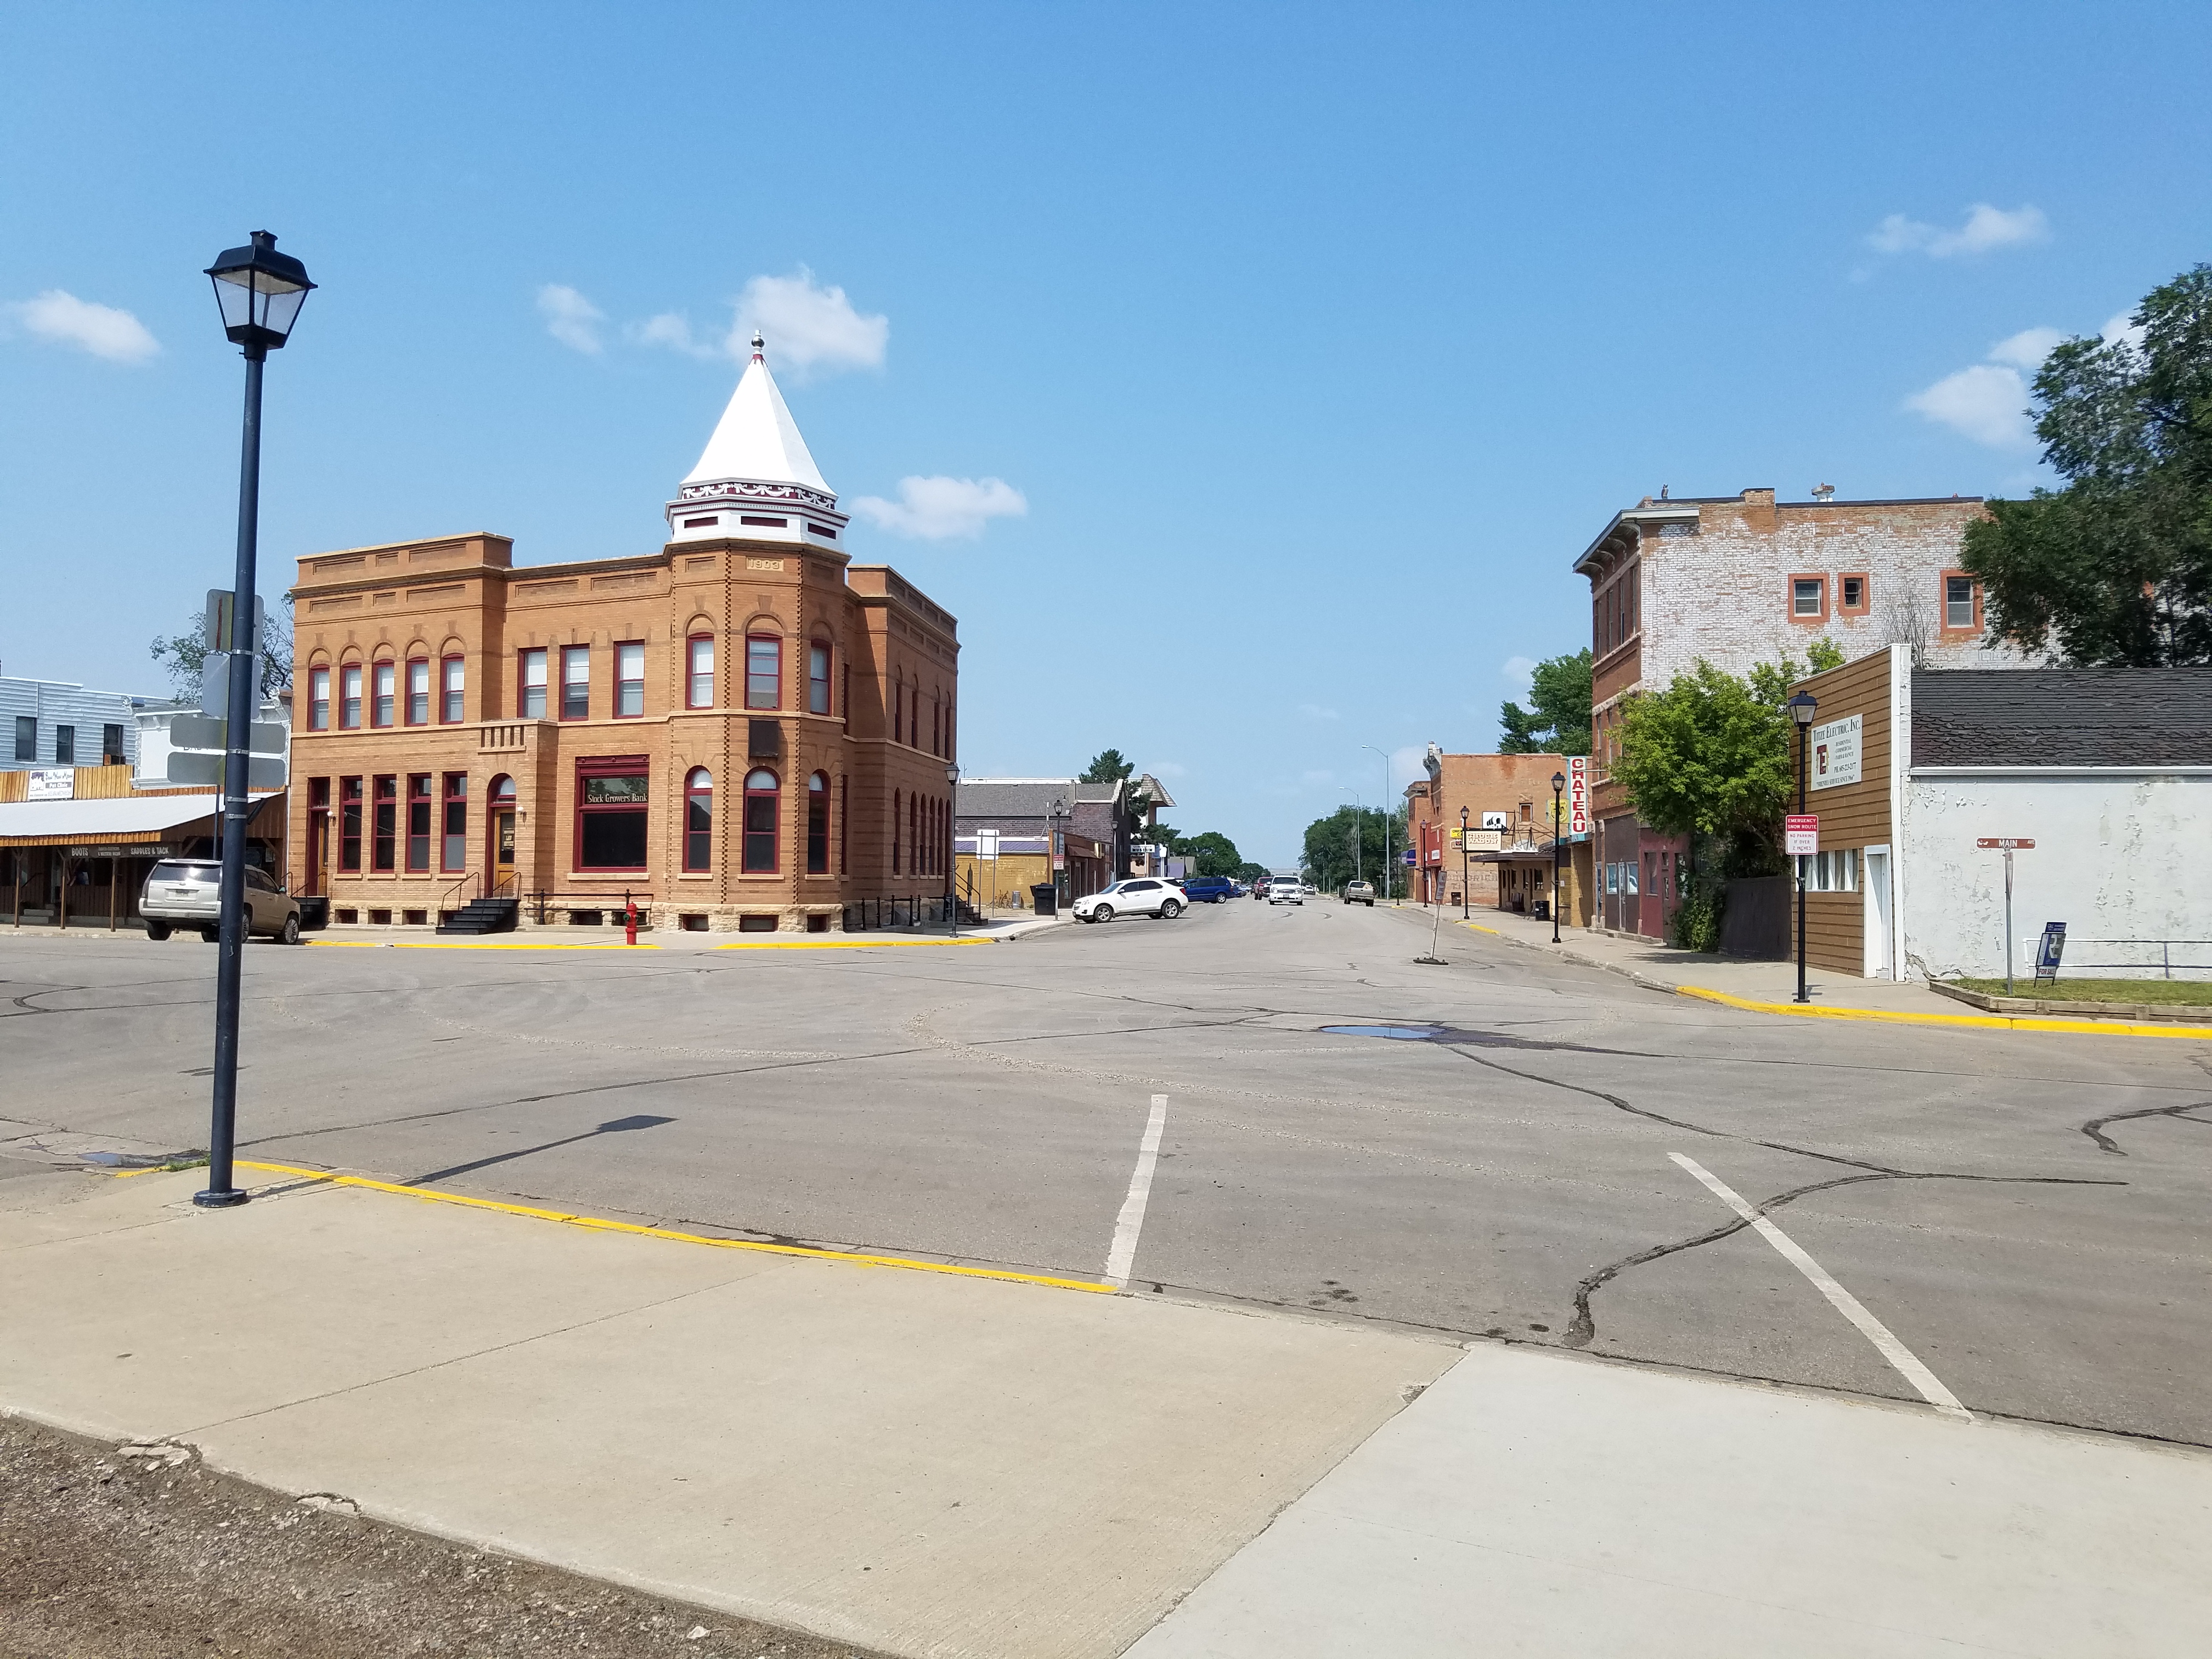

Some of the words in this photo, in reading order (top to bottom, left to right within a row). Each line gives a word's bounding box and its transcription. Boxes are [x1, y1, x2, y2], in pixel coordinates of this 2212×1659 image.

[748, 558, 779, 569] 1903
[1826, 723, 1849, 738] ELECTRIC,
[1850, 719, 1860, 731] INC.
[588, 794, 603, 803] Stock
[605, 793, 630, 803] Growers
[632, 793, 647, 802] Bank
[1572, 759, 1585, 832] CHATEAU
[1999, 839, 2018, 848] MAIN
[71, 847, 88, 856] BOOTS
[156, 847, 169, 855] TACK
